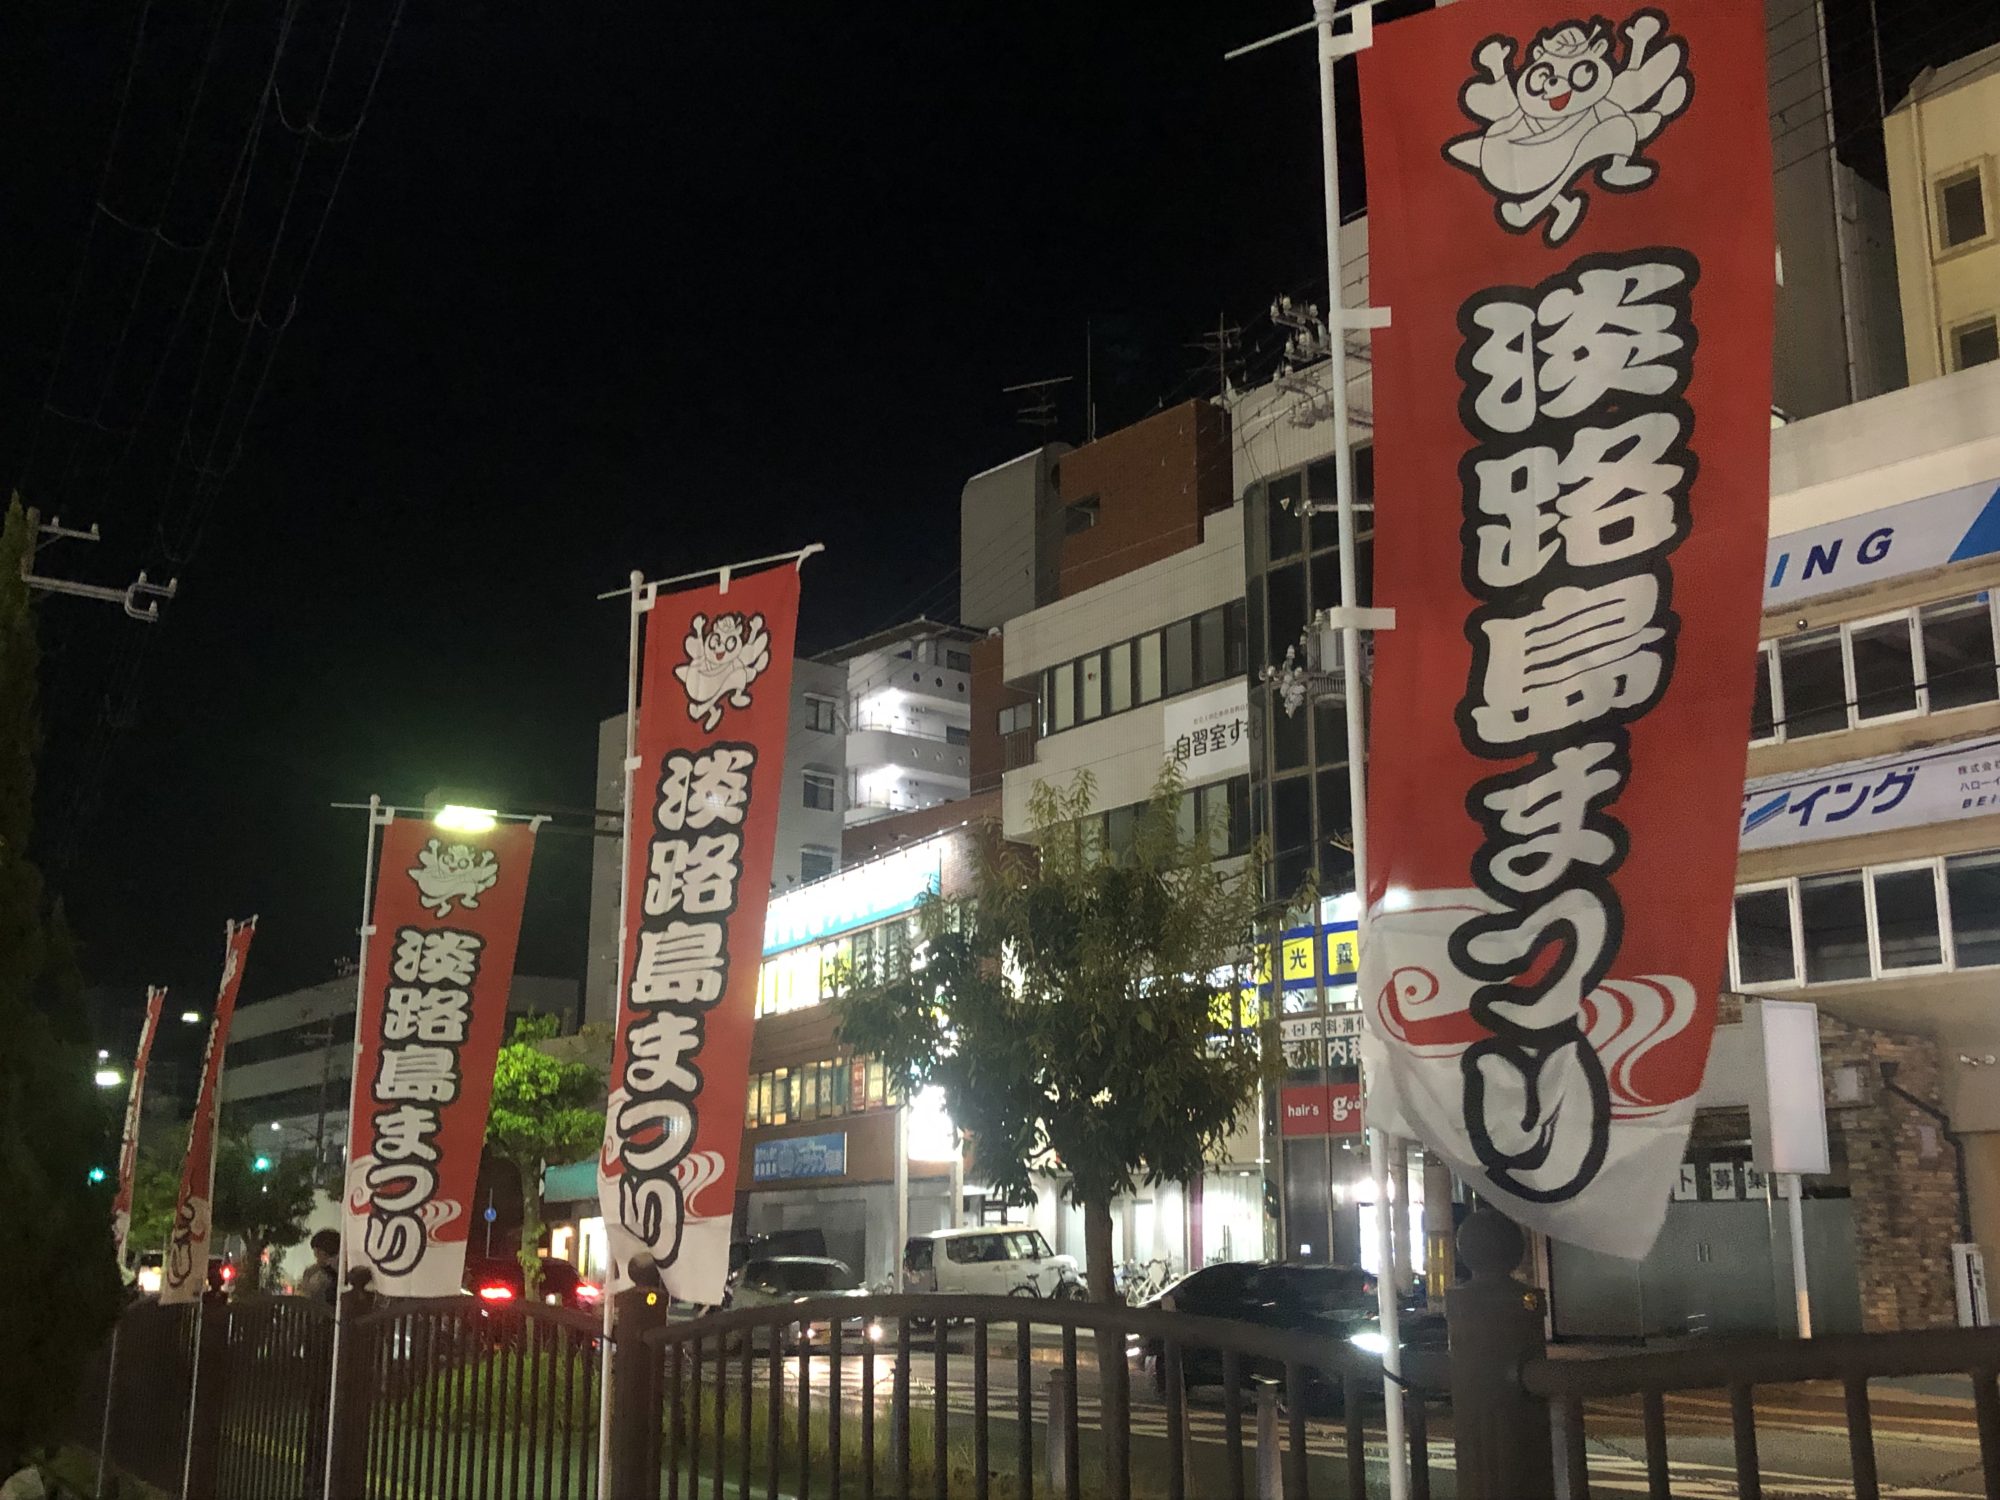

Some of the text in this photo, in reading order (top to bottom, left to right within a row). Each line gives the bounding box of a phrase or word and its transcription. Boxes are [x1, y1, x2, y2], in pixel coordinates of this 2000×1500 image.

[1771, 526, 1895, 589] ING
[1447, 251, 1698, 1200] 淡路島まつり
[1962, 794, 2000, 809] BEI
[365, 927, 486, 1275] 淡路島まつり
[617, 742, 757, 1269] 淡路島まつり
[1287, 1104, 1319, 1117] hair's
